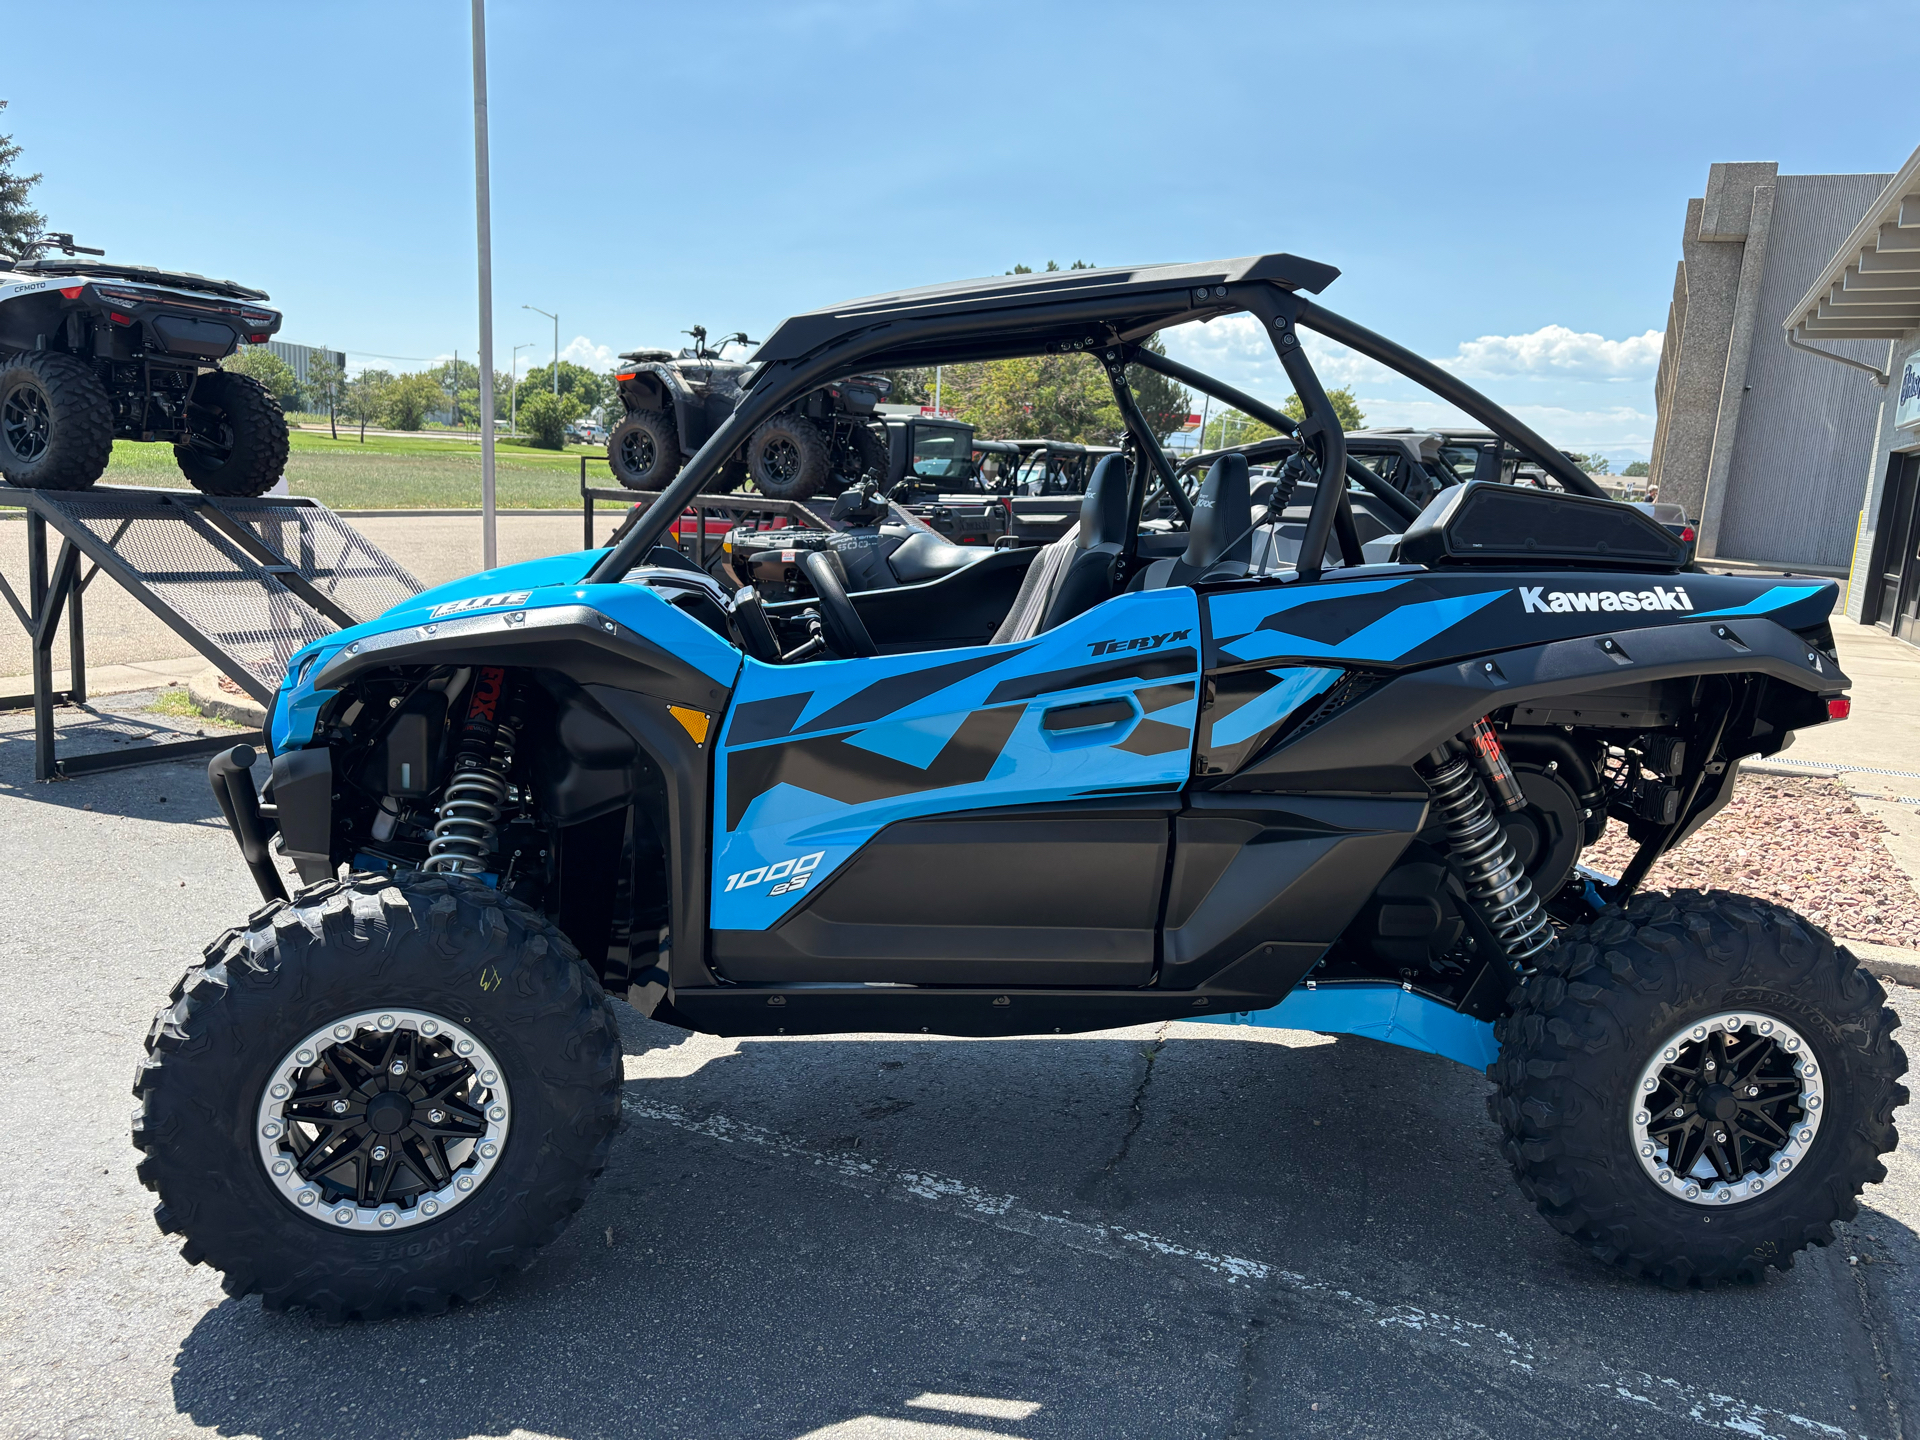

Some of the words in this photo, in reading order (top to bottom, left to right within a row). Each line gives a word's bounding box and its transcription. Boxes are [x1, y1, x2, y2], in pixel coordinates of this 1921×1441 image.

[14, 282, 46, 293] CFMOTO
[837, 540, 869, 552] 500
[426, 590, 533, 619] ELITE
[1518, 586, 1694, 613] Kawasaki
[469, 666, 505, 721] FOX
[723, 850, 826, 893] 1000
[1735, 990, 1840, 1044] CARNIVORE
